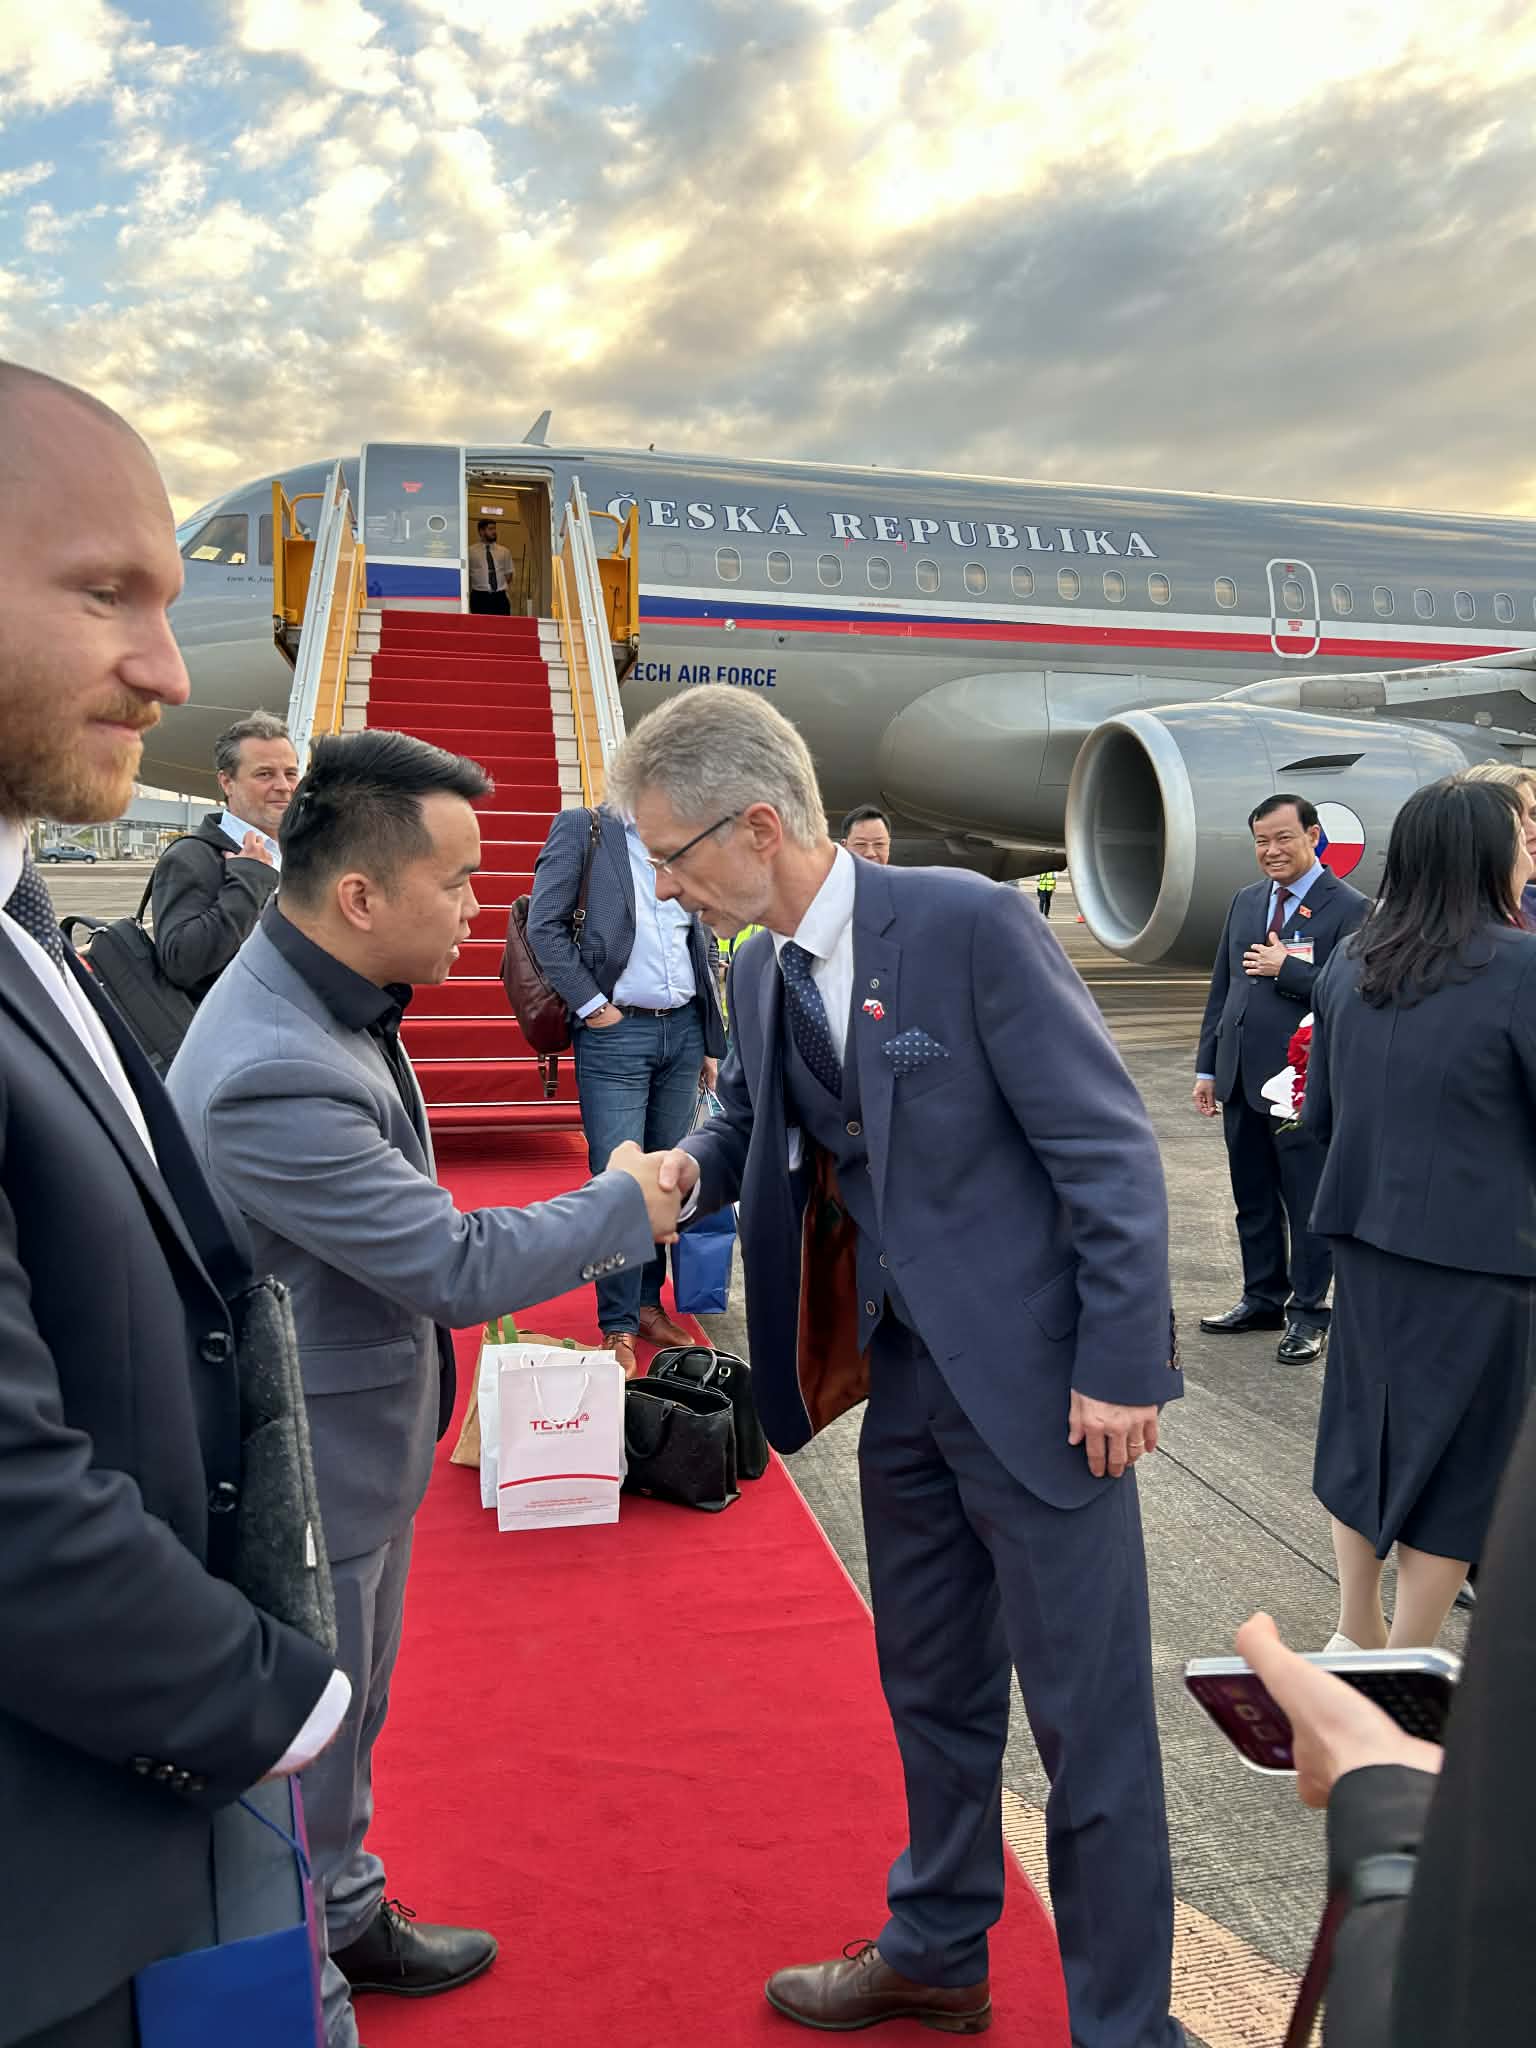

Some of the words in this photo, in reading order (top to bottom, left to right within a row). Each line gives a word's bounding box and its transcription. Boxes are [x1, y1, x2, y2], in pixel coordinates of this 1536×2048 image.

[606, 491, 808, 537] ČESKÁ
[828, 512, 1159, 559] REPUBLIKA
[625, 662, 671, 682] ECH
[677, 664, 712, 684] AIR
[717, 665, 777, 687] FORCE
